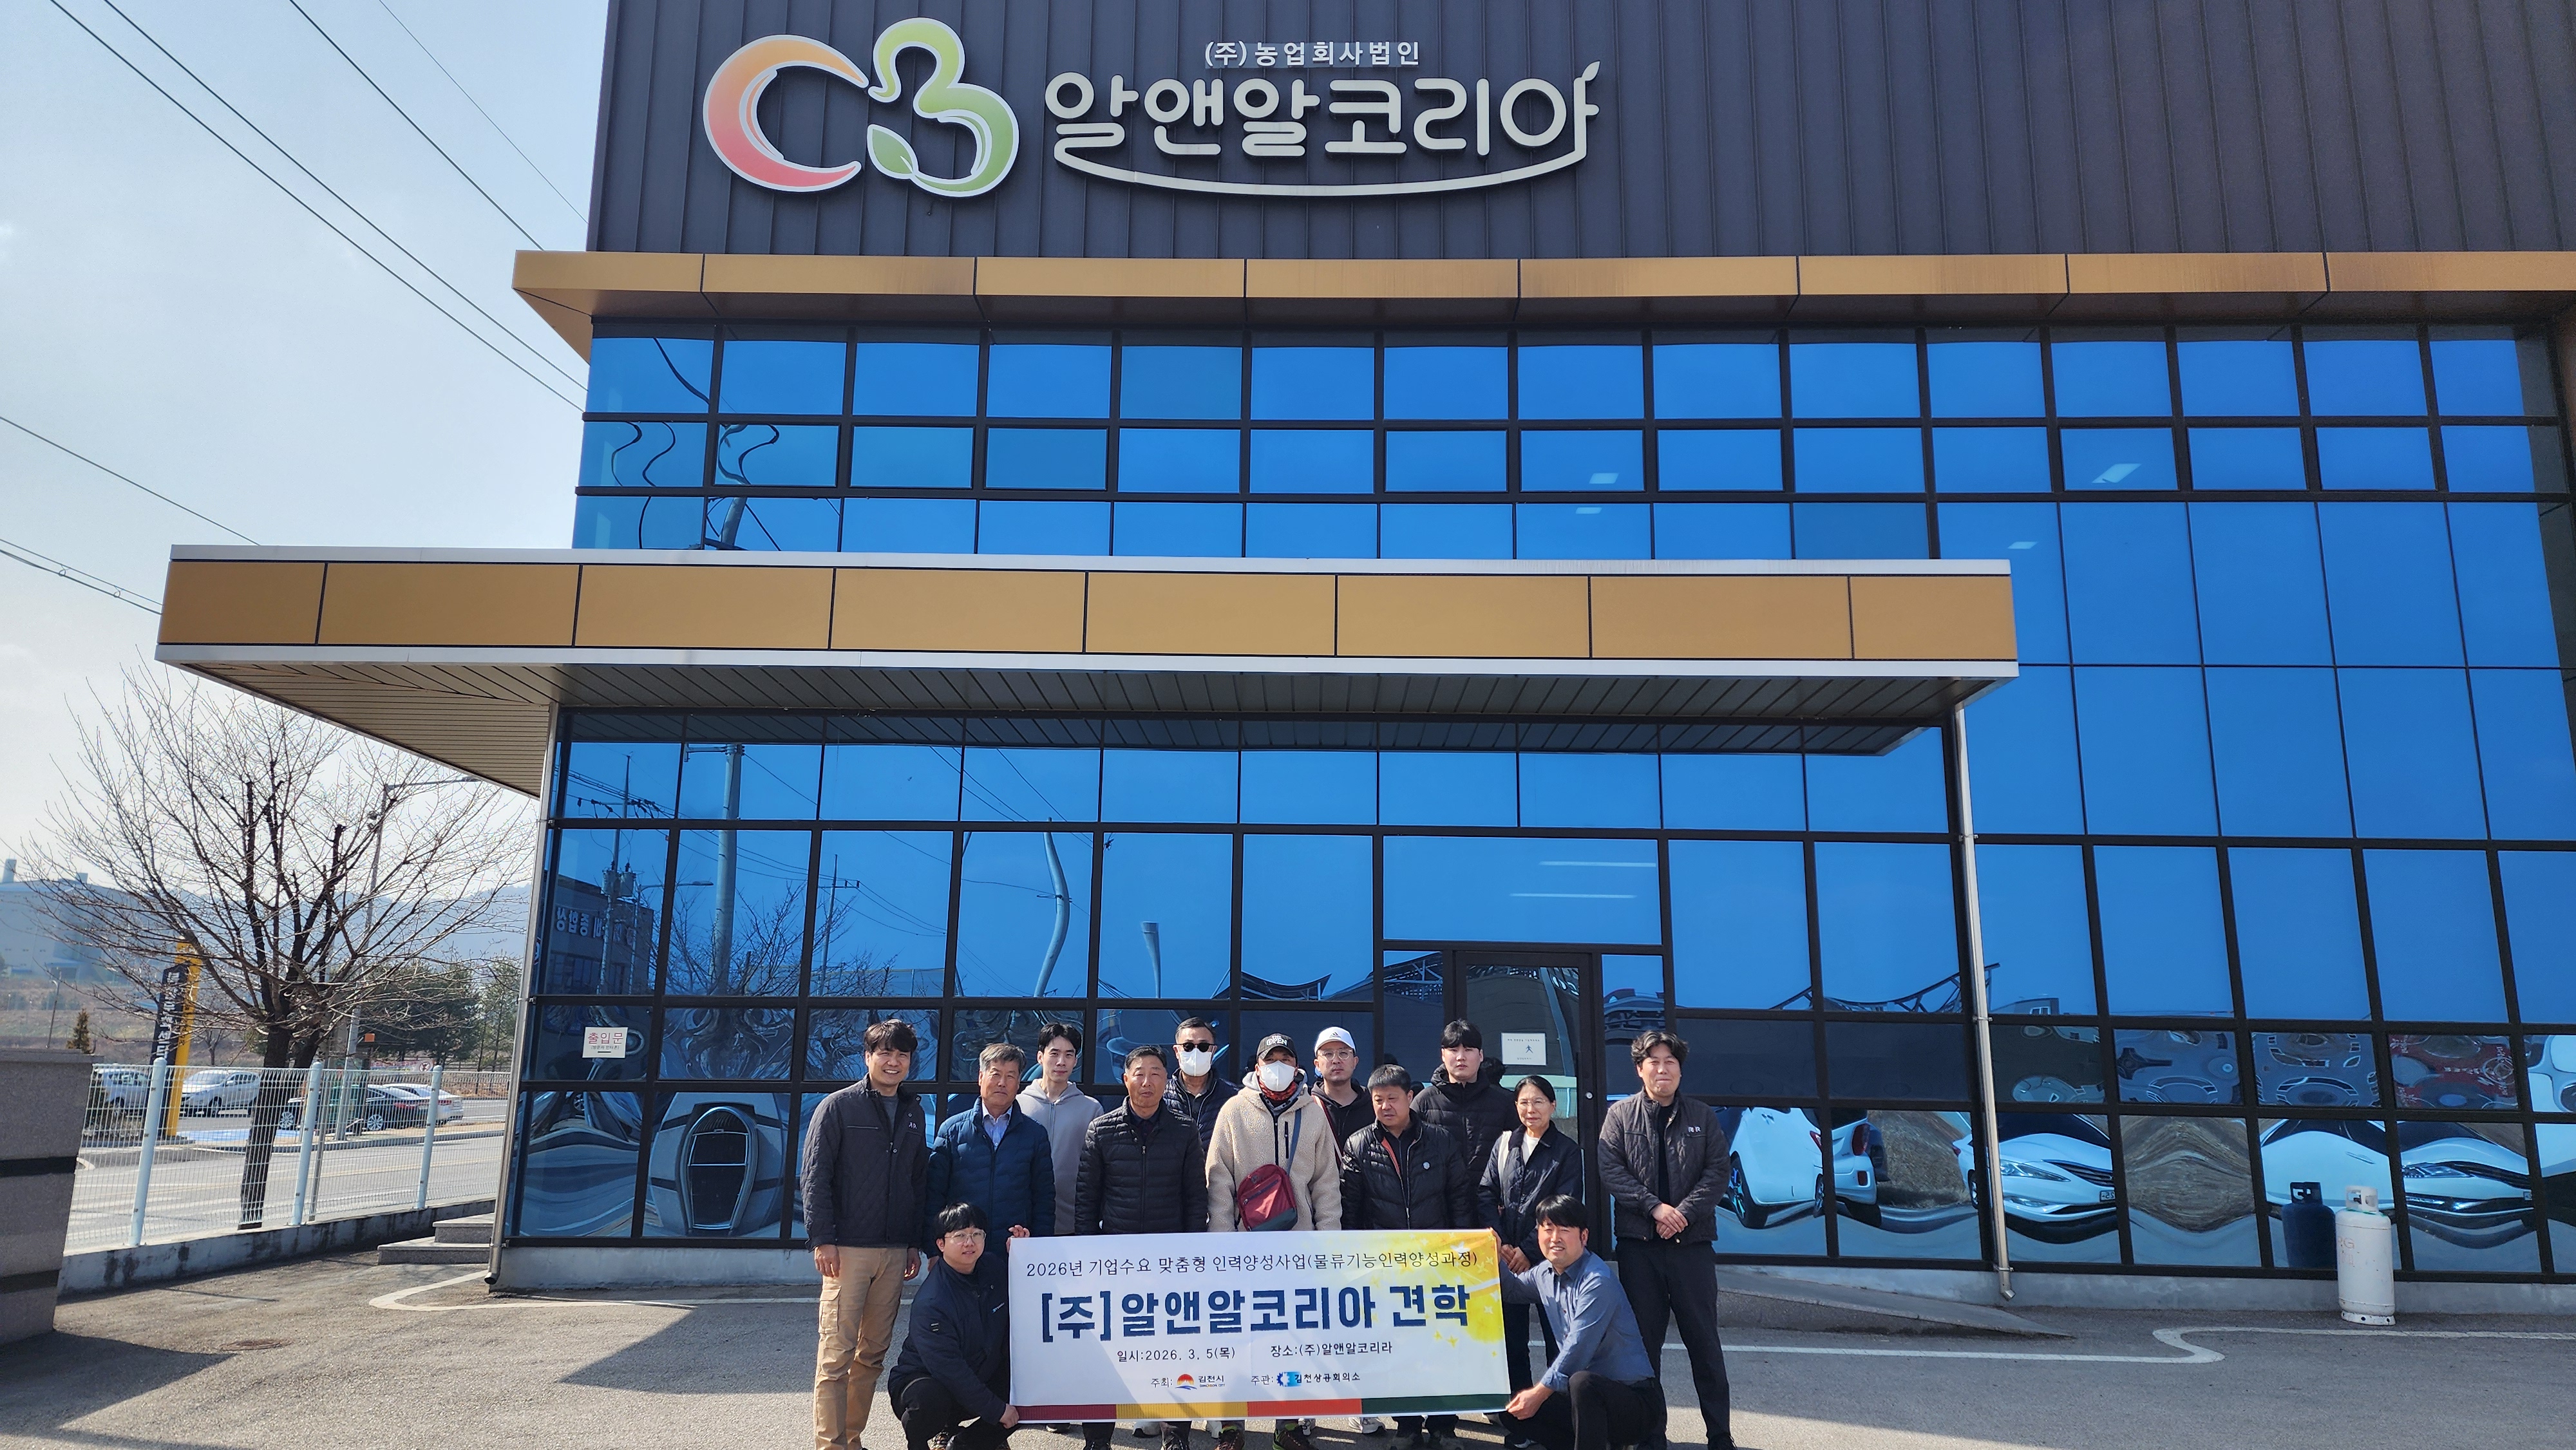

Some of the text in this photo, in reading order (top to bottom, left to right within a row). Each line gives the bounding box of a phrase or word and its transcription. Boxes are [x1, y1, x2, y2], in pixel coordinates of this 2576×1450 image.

[1045, 62, 1600, 196] 알앤알코리아
[588, 1033, 623, 1044] 출입문
[1267, 1037, 1287, 1046] OPEN
[1027, 1251, 1477, 1277] 2026년 기업수요 맞춤형 인력양성사업(물류기능인력양성과정)
[1389, 1284, 1470, 1327] 견학
[1188, 1348, 1200, 1360] 3.
[1206, 1346, 1235, 1359] 5(목)
[1151, 1377, 1173, 1388] 주최:
[1251, 1375, 1274, 1386] 주관:
[1294, 1372, 1361, 1383] 김천상공회의소
